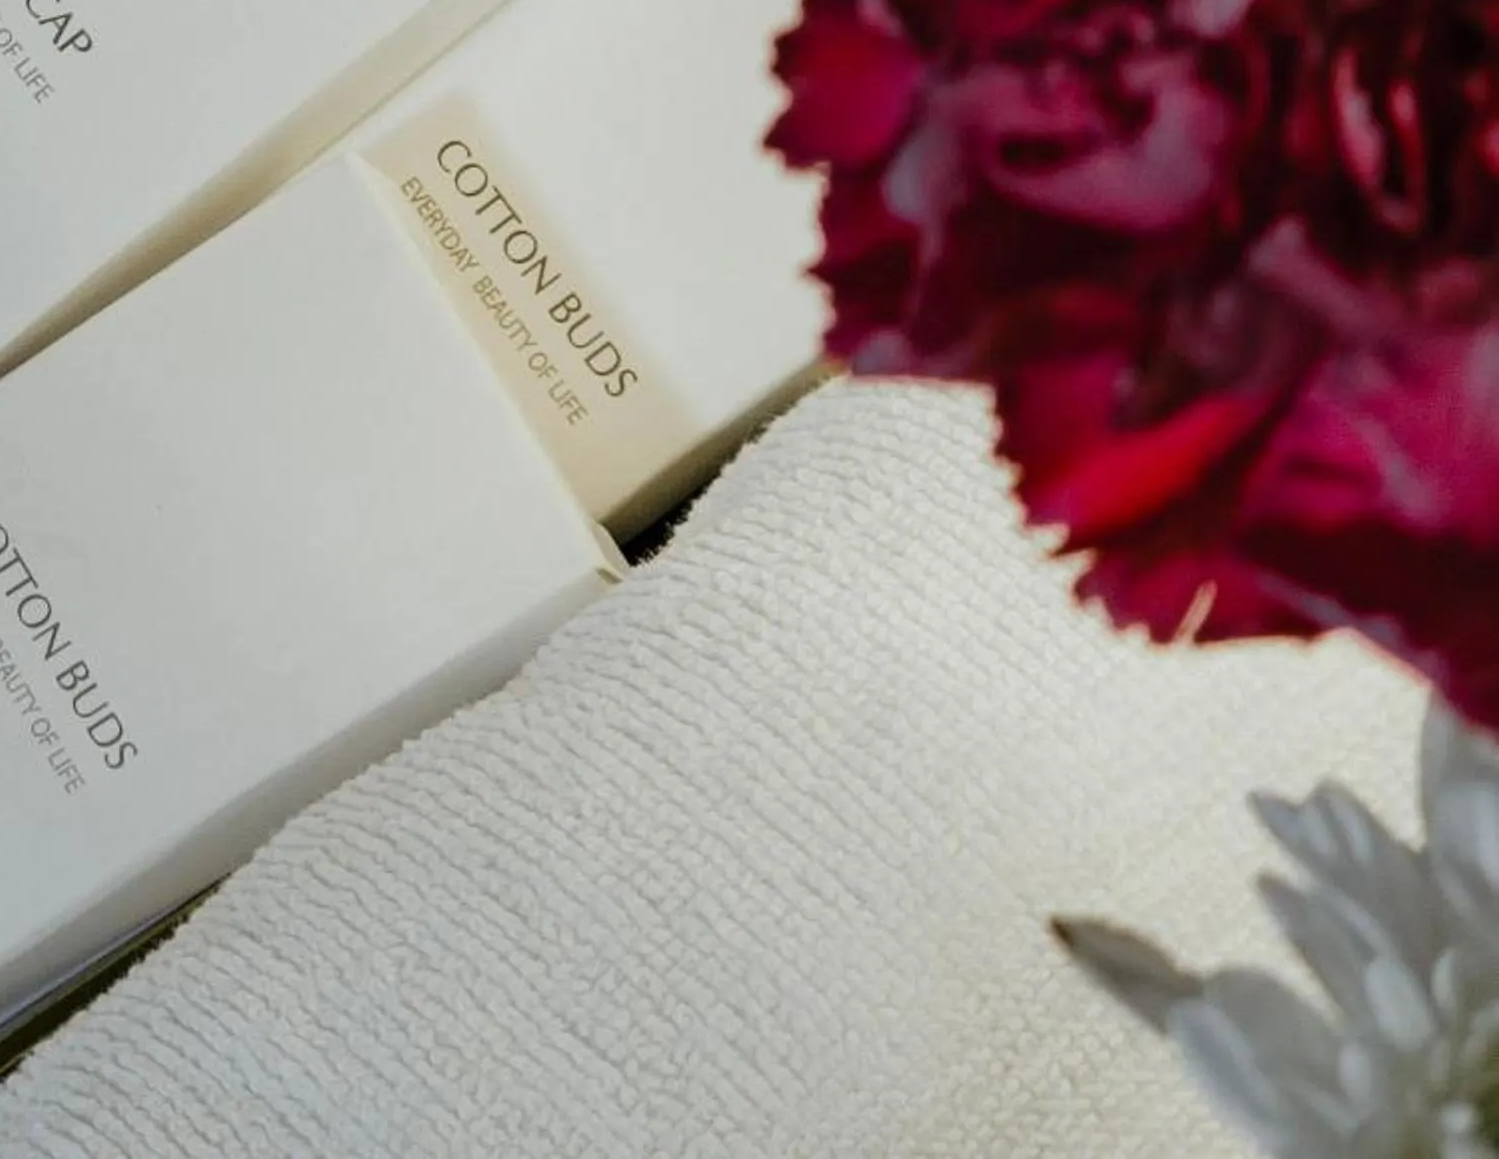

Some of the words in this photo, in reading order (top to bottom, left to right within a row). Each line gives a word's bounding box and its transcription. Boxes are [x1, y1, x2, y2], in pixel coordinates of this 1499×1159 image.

[13, 56, 55, 104] LIFE
[400, 176, 480, 273] EVERYDAY
[472, 275, 538, 352] BEAUTY
[528, 351, 559, 380] OF
[548, 379, 589, 425] LIFE
[436, 140, 562, 295] COTTON
[548, 292, 638, 398] BUDS
[30, 717, 60, 746] OF
[47, 747, 86, 795] LIFE
[56, 660, 138, 770] BUDS
